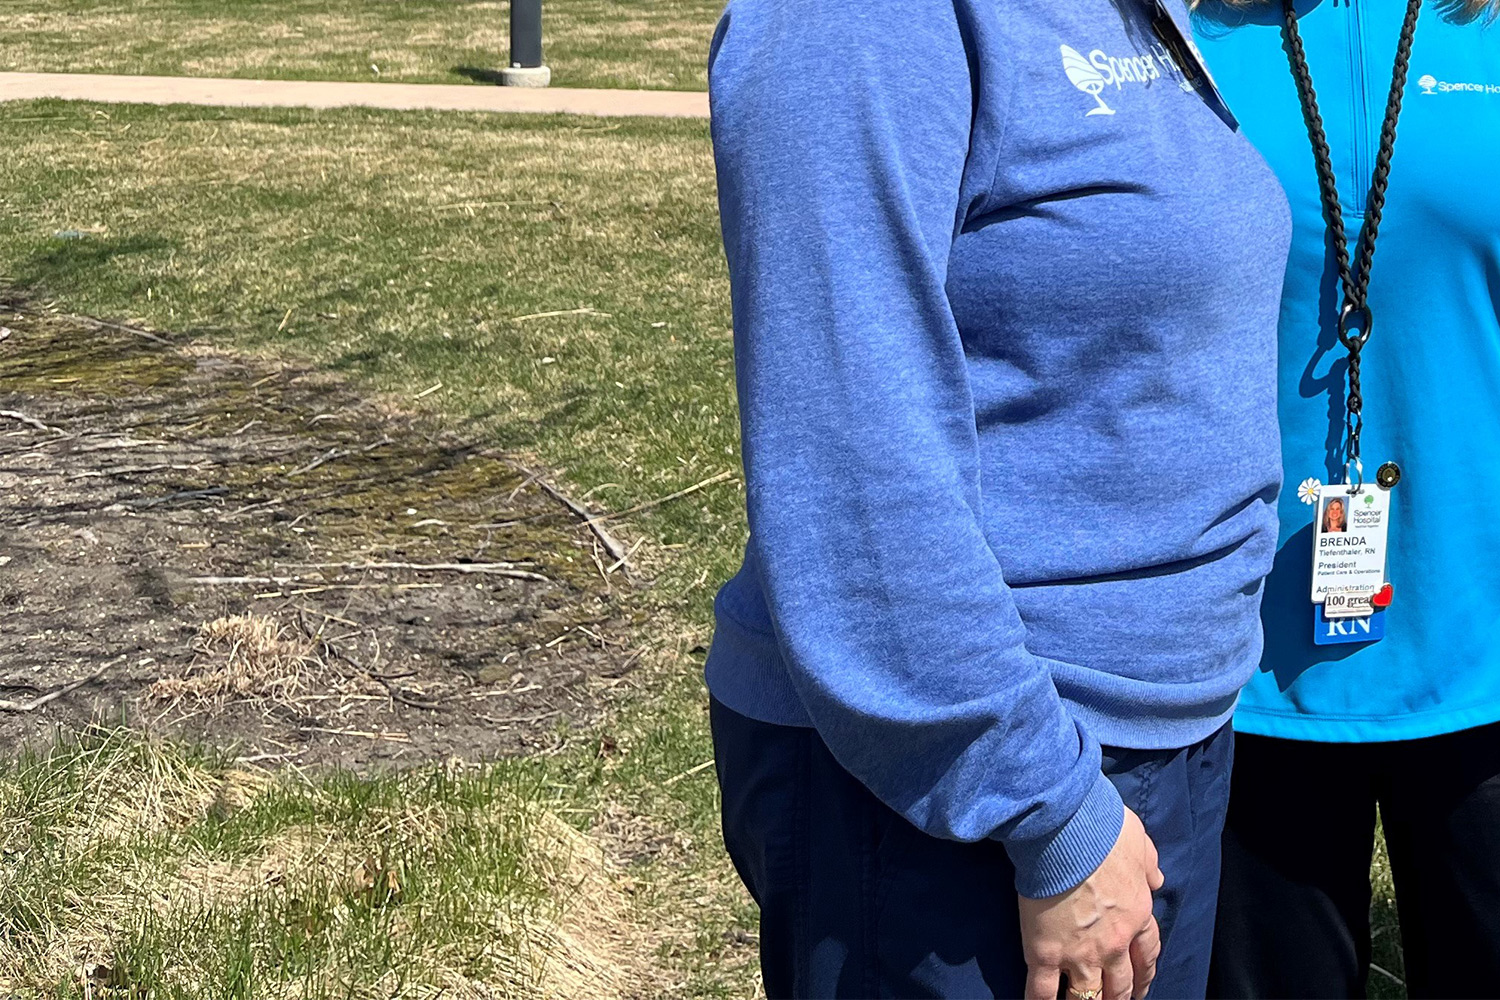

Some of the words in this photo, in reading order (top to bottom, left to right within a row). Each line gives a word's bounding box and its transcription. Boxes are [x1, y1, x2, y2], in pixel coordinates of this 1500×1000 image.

[1438, 81, 1484, 93] Spencer
[1353, 510, 1382, 518] Spencer
[1353, 516, 1381, 525] Hospital
[1320, 536, 1367, 547] BRENDA
[1364, 547, 1376, 555] RN
[1318, 561, 1357, 570] President
[1316, 584, 1375, 594] Administration
[1326, 595, 1346, 607] 100
[1346, 597, 1373, 608] grea
